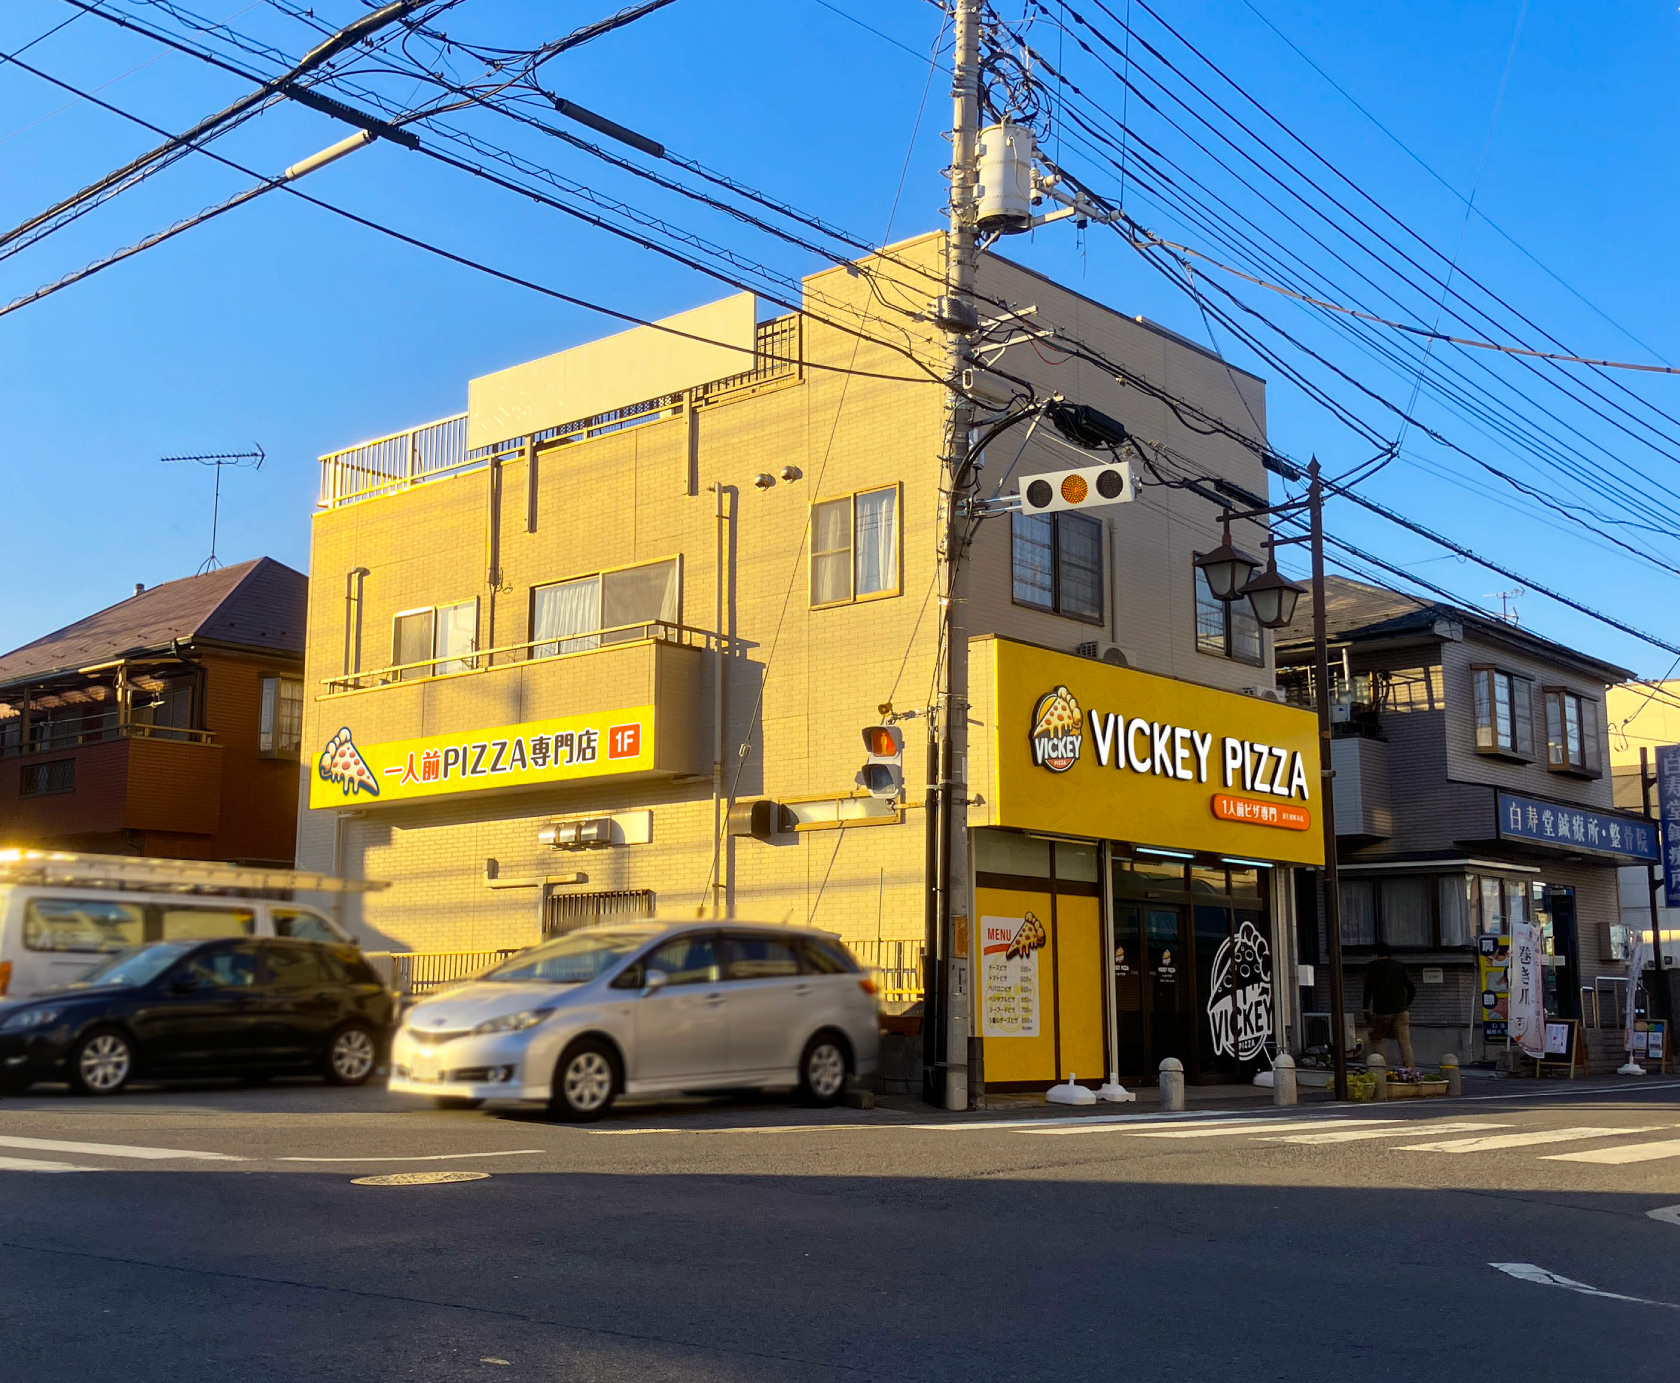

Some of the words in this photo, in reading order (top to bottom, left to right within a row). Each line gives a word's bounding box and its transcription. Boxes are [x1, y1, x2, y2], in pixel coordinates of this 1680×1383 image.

[615, 731, 635, 754] 1F
[1034, 735, 1082, 764] VICKEY
[1091, 709, 1212, 783] VICKEY
[1224, 737, 1309, 800] PIZZA
[384, 729, 599, 784] 一人前PIZZA専門店
[1222, 800, 1277, 822] 1人前ピザ専門
[987, 928, 1012, 941] MENU
[1211, 998, 1273, 1052] VICKEY
[1239, 1039, 1255, 1050] PIZZA
